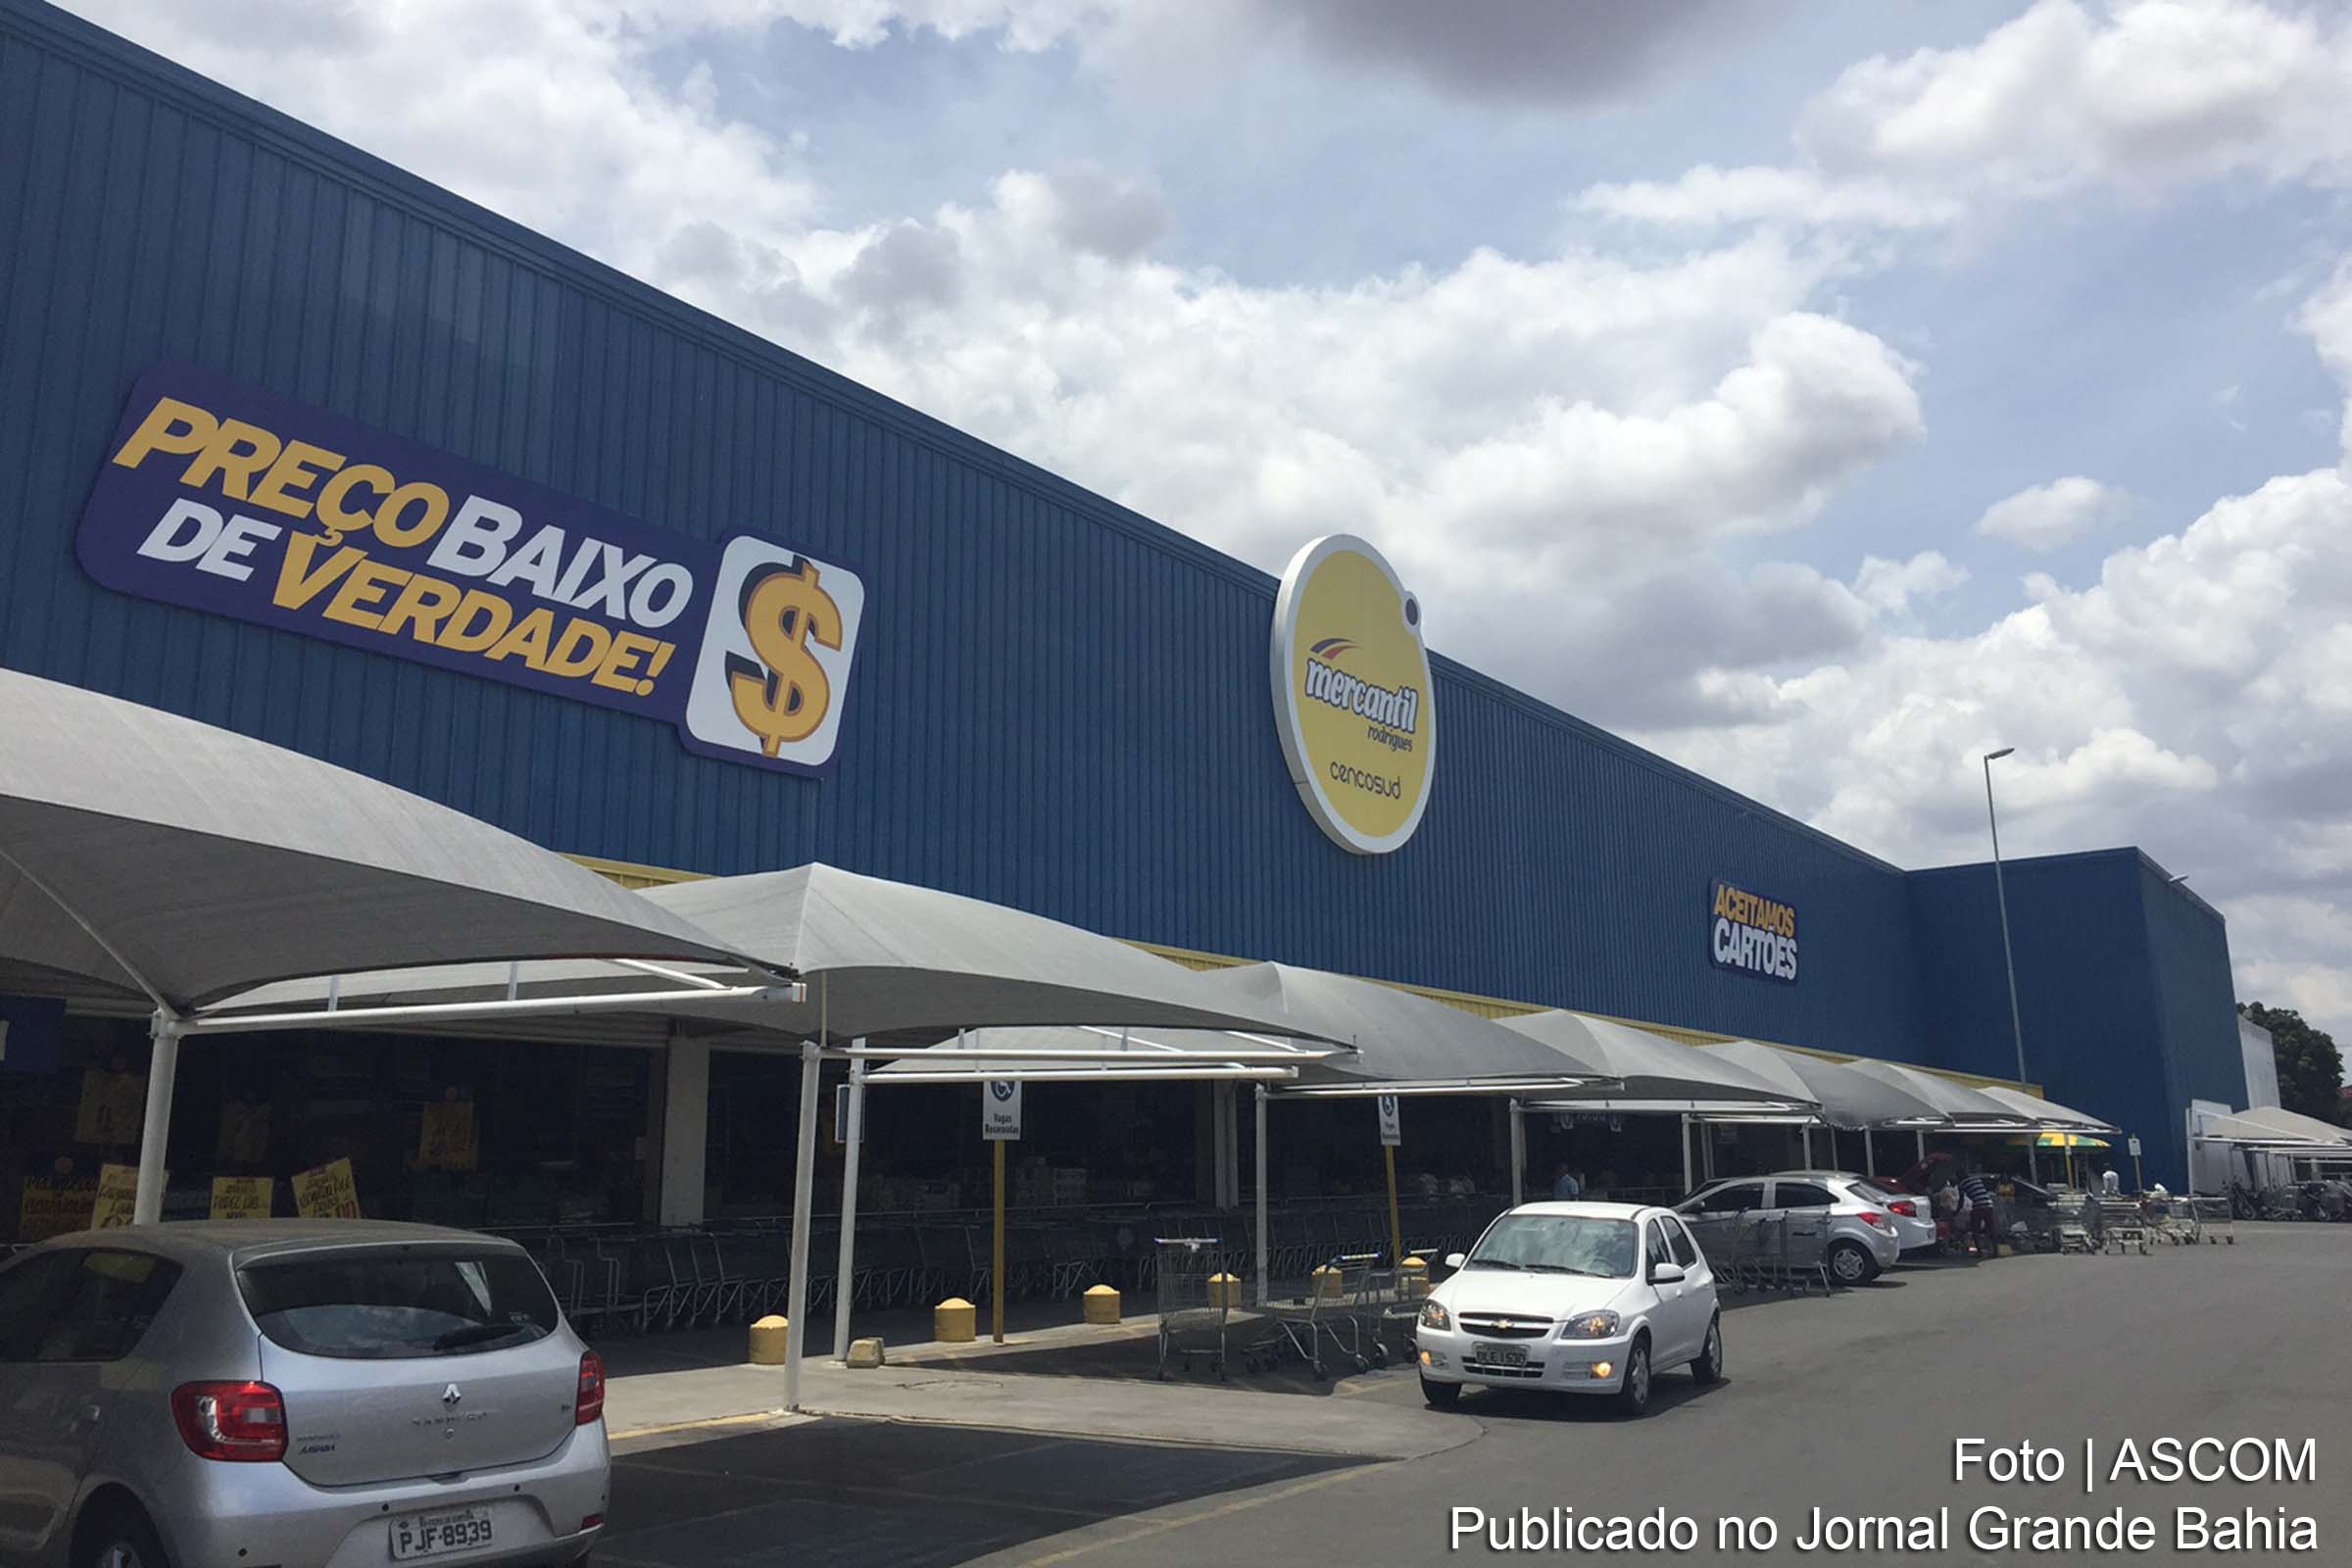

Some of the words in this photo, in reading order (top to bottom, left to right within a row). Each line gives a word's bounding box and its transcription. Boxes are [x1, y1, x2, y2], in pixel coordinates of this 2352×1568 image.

[113, 396, 450, 547] PREÇO
[426, 495, 694, 628] BAIXO
[137, 498, 281, 581] DE
[270, 532, 677, 698] VERDADE!
[1305, 658, 1419, 733] mercantil
[1368, 726, 1413, 752] rodrigues
[1329, 760, 1401, 800] cencosud
[1713, 884, 1795, 938] ACEITAMOS
